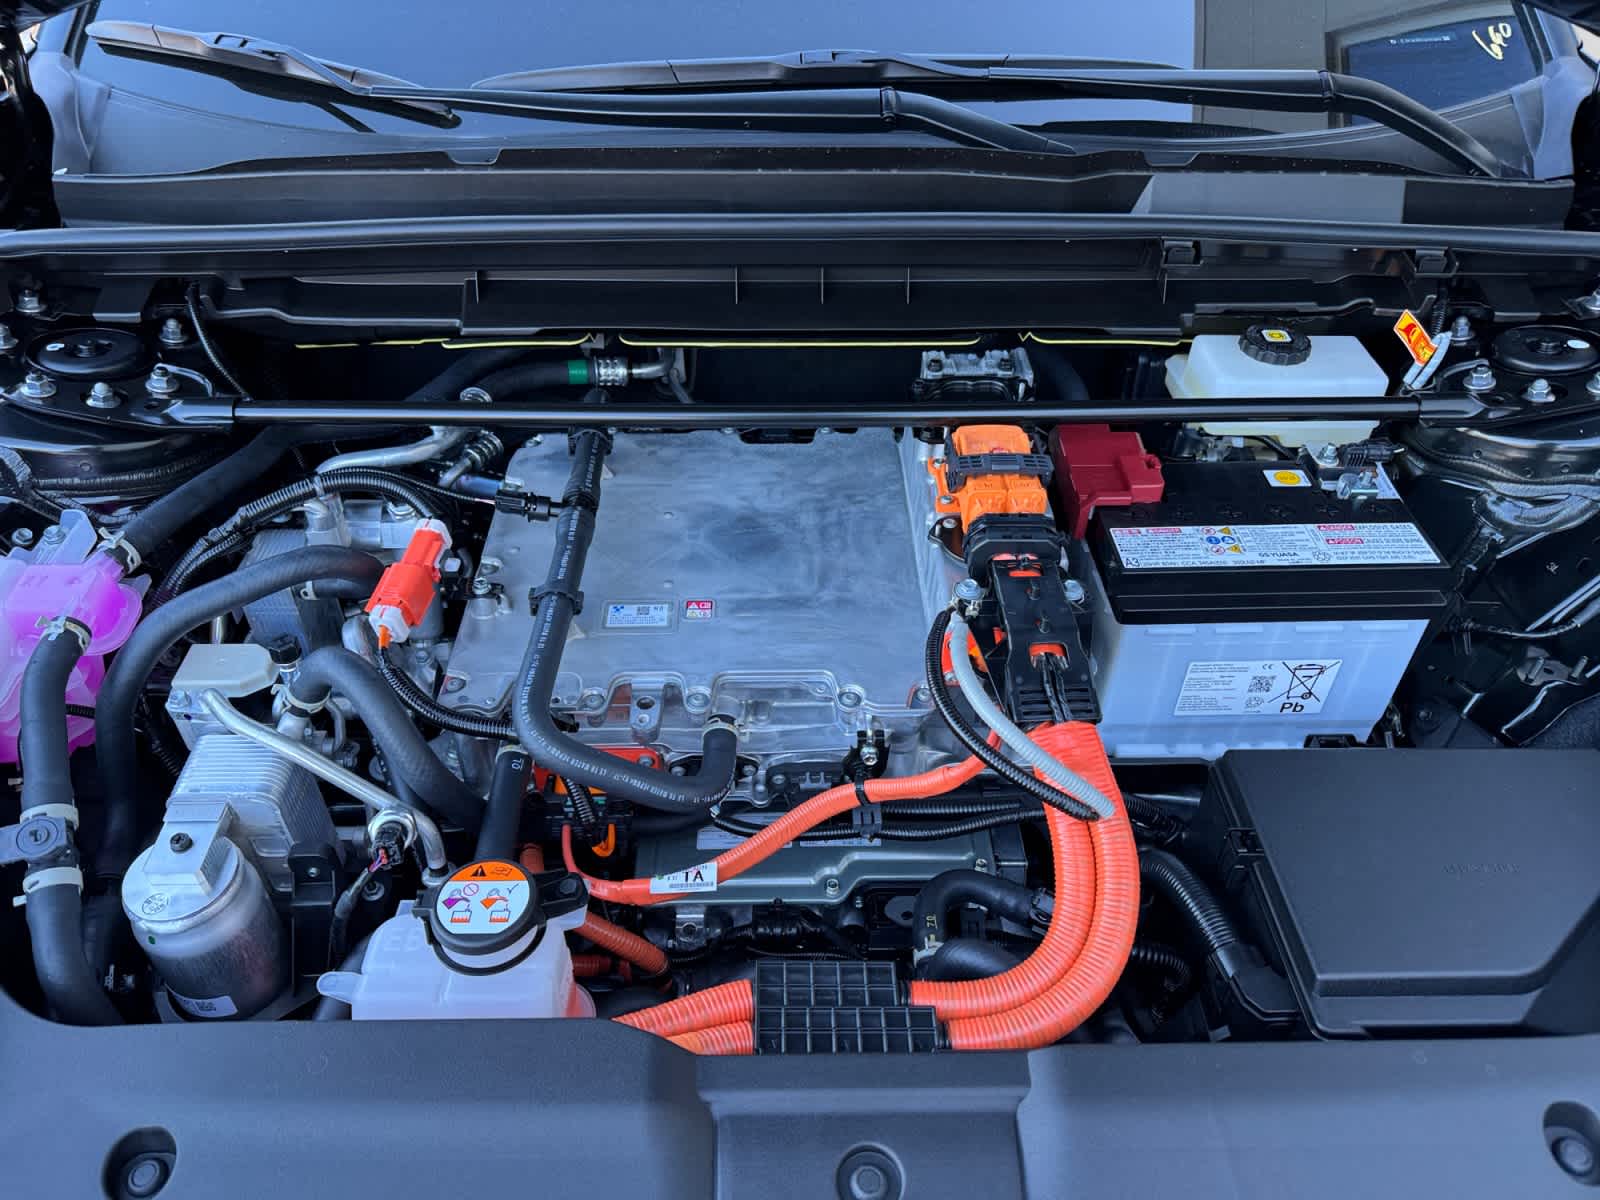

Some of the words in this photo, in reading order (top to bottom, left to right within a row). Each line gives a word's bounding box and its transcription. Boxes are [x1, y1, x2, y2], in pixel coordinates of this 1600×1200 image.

[1125, 557, 1141, 568] A3
[1279, 702, 1305, 713] Pb
[683, 870, 704, 882] TA
